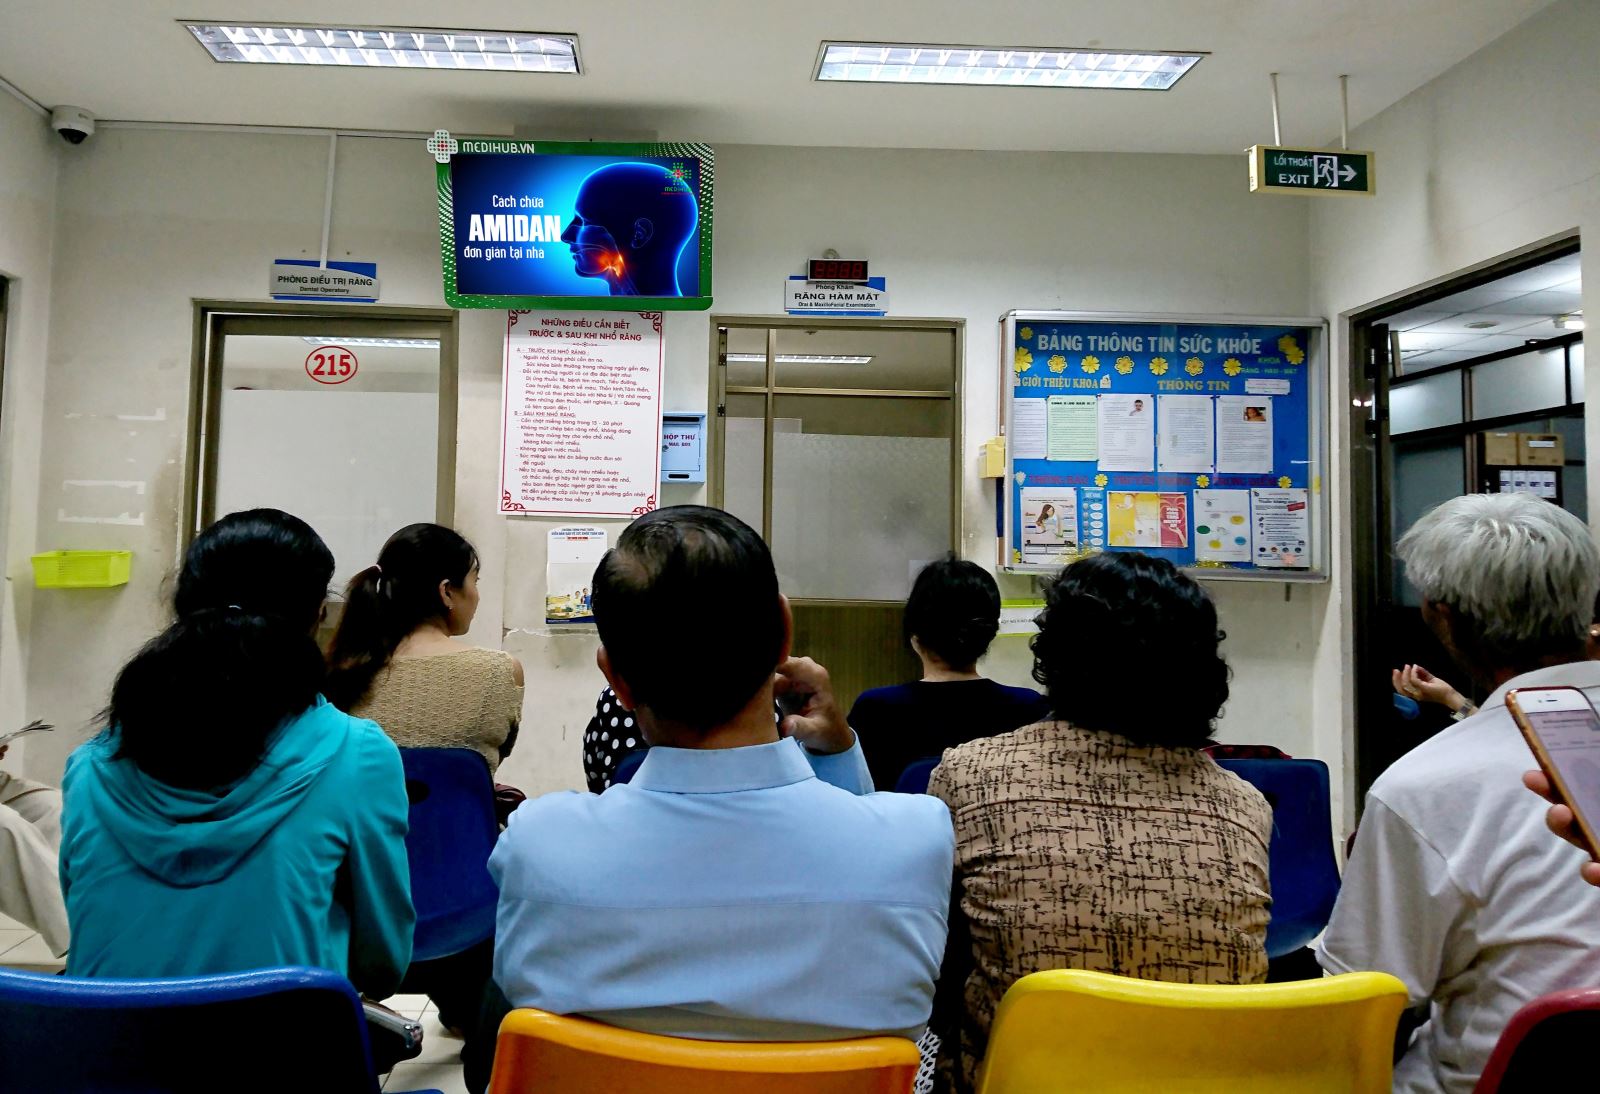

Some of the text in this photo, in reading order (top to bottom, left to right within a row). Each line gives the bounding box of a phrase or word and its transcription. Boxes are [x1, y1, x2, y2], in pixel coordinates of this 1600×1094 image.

[463, 141, 535, 154] MEDIHUB.VN
[1289, 156, 1313, 166] THOÁT
[1279, 173, 1309, 184] EXIT
[469, 214, 561, 242] AMIDAN
[464, 246, 482, 258] đơn
[510, 246, 522, 260] tại
[278, 275, 308, 284] PHÒNG
[333, 278, 346, 286] TRỊ
[795, 292, 880, 301] RĂNG HÀM MẶT
[1038, 329, 1262, 354] BẢNG THÔNG TIN SỨC KHỎE
[313, 354, 351, 376] 215
[1043, 376, 1071, 390] THIỆU
[1073, 378, 1098, 389] KHOA
[1157, 378, 1230, 391] THÔNG TIN
